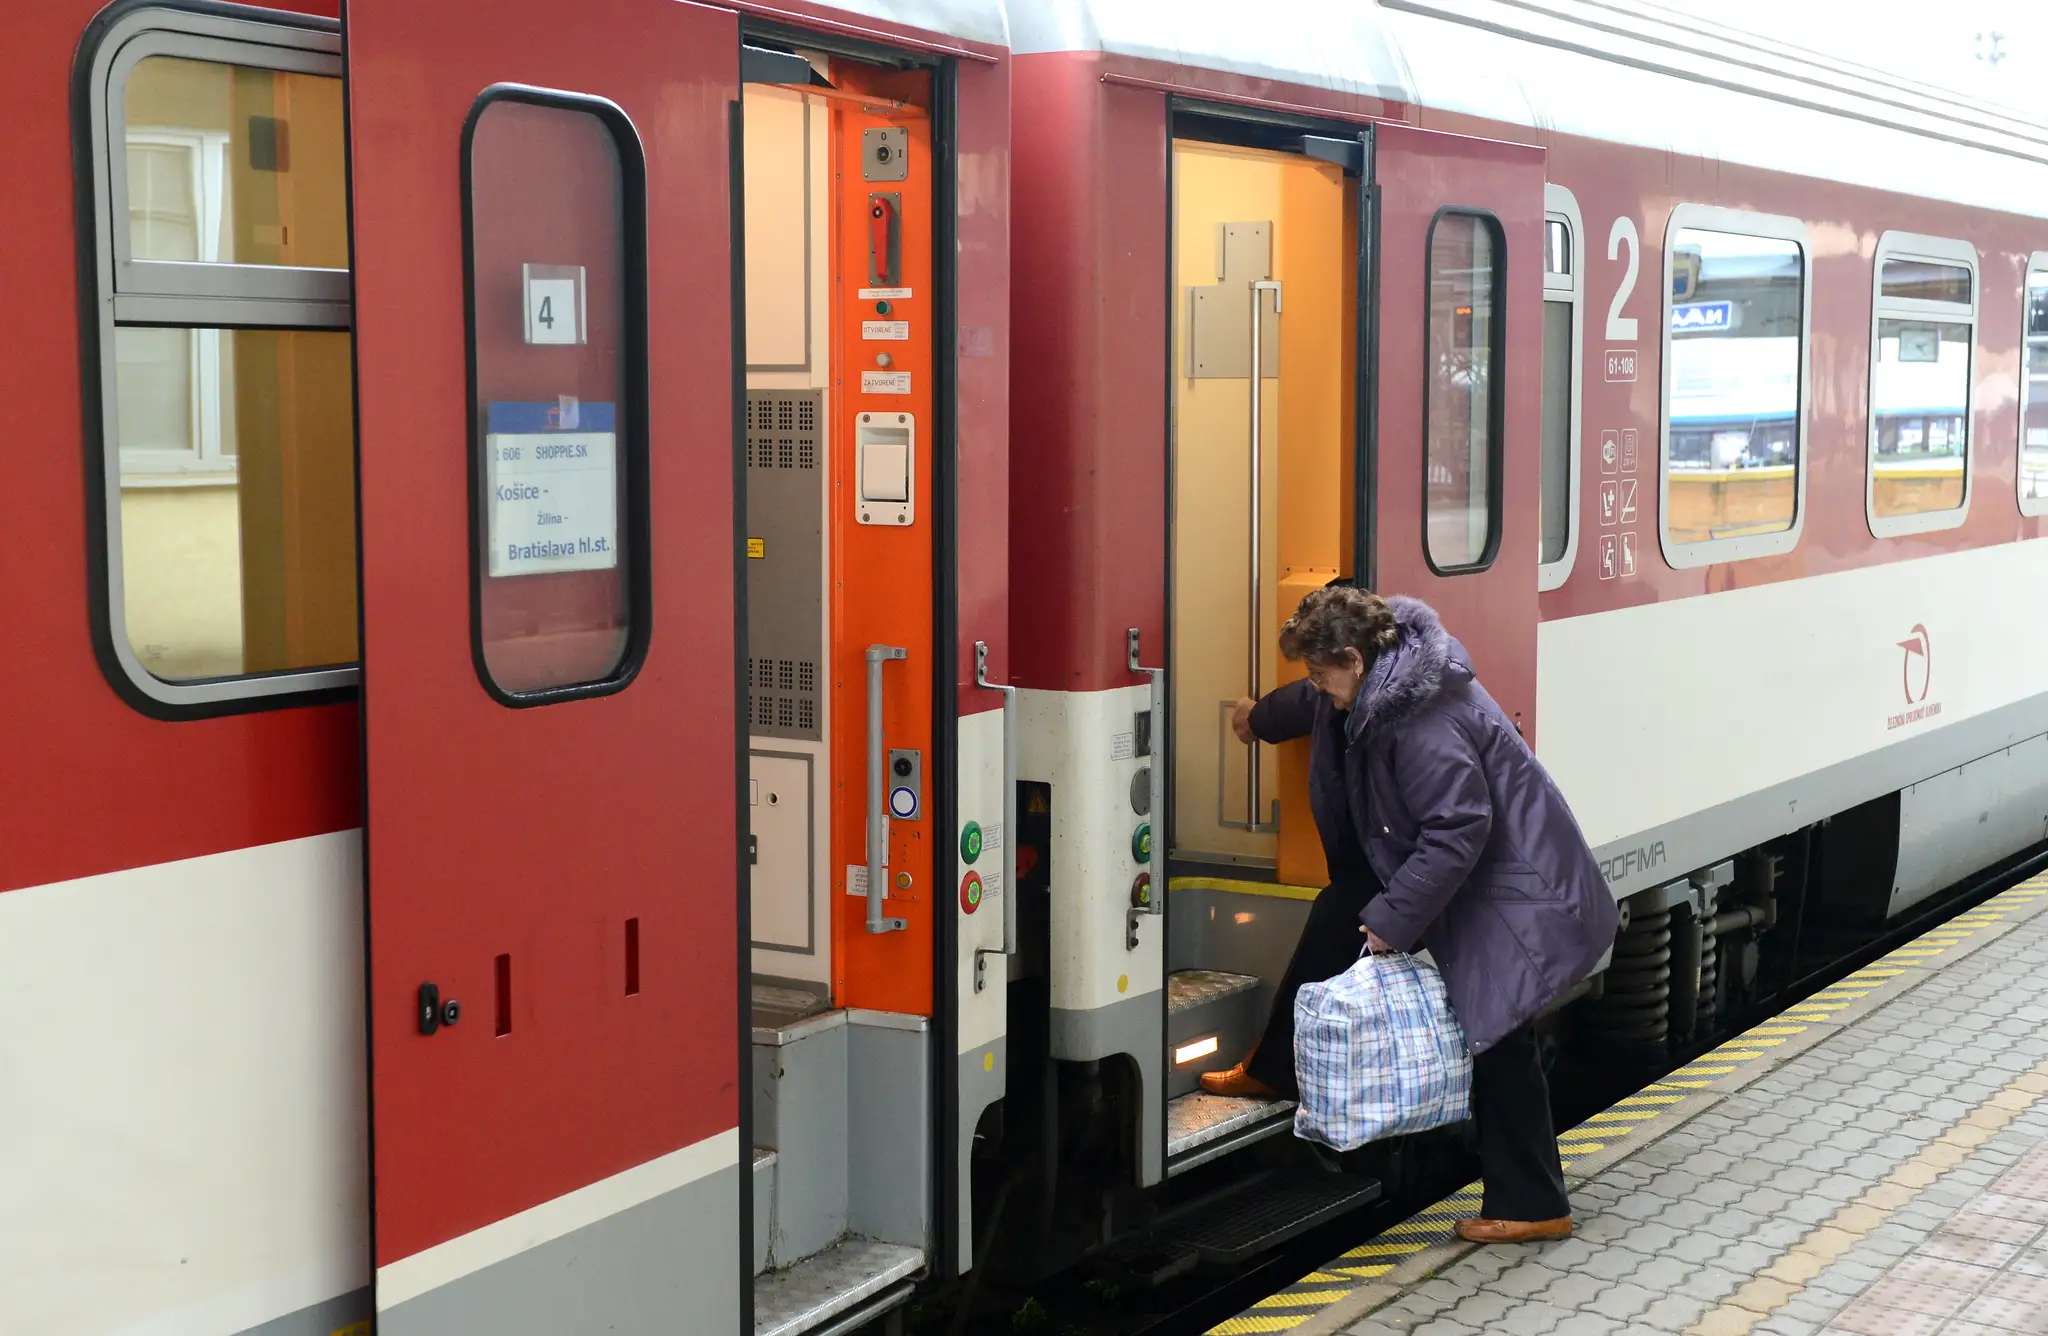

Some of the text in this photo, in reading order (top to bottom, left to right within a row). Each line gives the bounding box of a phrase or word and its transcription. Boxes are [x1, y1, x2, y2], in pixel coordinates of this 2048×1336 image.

[1605, 215, 1640, 341] 2
[538, 295, 554, 330] 4
[1608, 357, 1635, 375] 61-108
[863, 377, 896, 387] ZATVORENÉ
[502, 447, 520, 461] 606
[535, 444, 588, 460] SHOPPIE.SK
[537, 510, 562, 526] Žilina
[508, 536, 610, 561] Bratislava hl.st.
